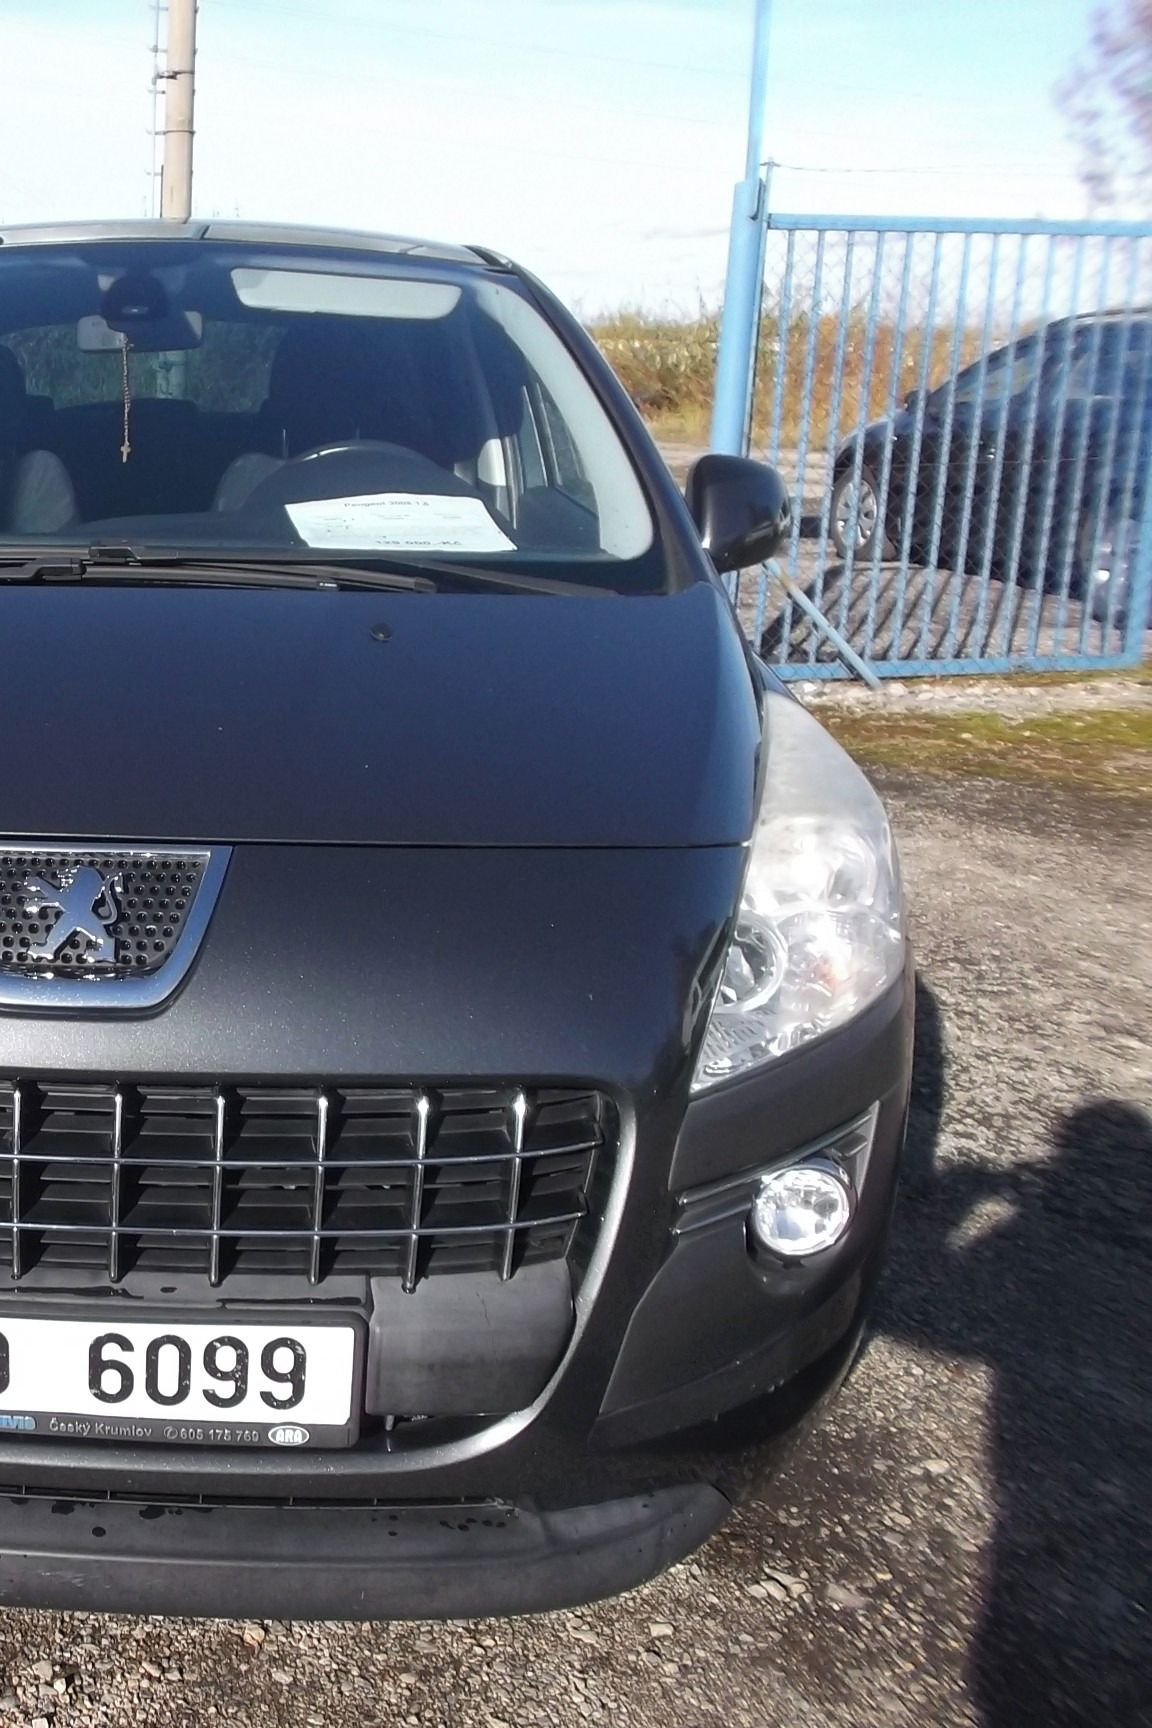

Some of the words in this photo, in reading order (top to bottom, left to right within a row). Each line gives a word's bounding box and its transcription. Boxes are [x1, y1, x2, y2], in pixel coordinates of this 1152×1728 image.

[88, 1332, 307, 1410] 6099
[95, 1422, 152, 1437] Krumlov
[275, 1429, 303, 1443] ARA
